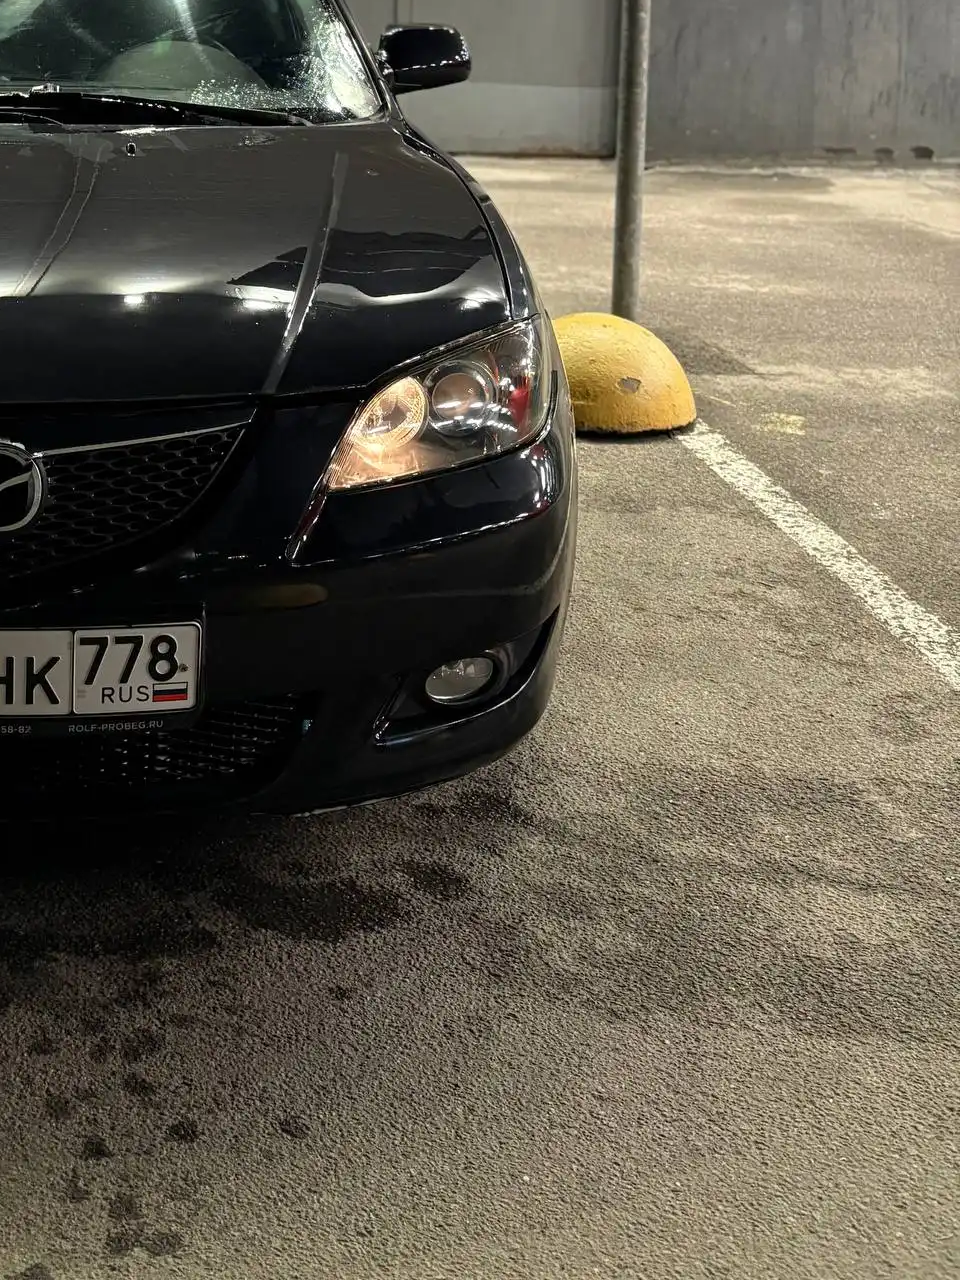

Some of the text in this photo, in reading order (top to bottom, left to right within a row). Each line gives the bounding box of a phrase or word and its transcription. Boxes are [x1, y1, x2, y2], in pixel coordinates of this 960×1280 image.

[79, 634, 179, 685] 778
[100, 686, 150, 704] RUS
[68, 720, 164, 733] ROLF-PROBEG.RU
